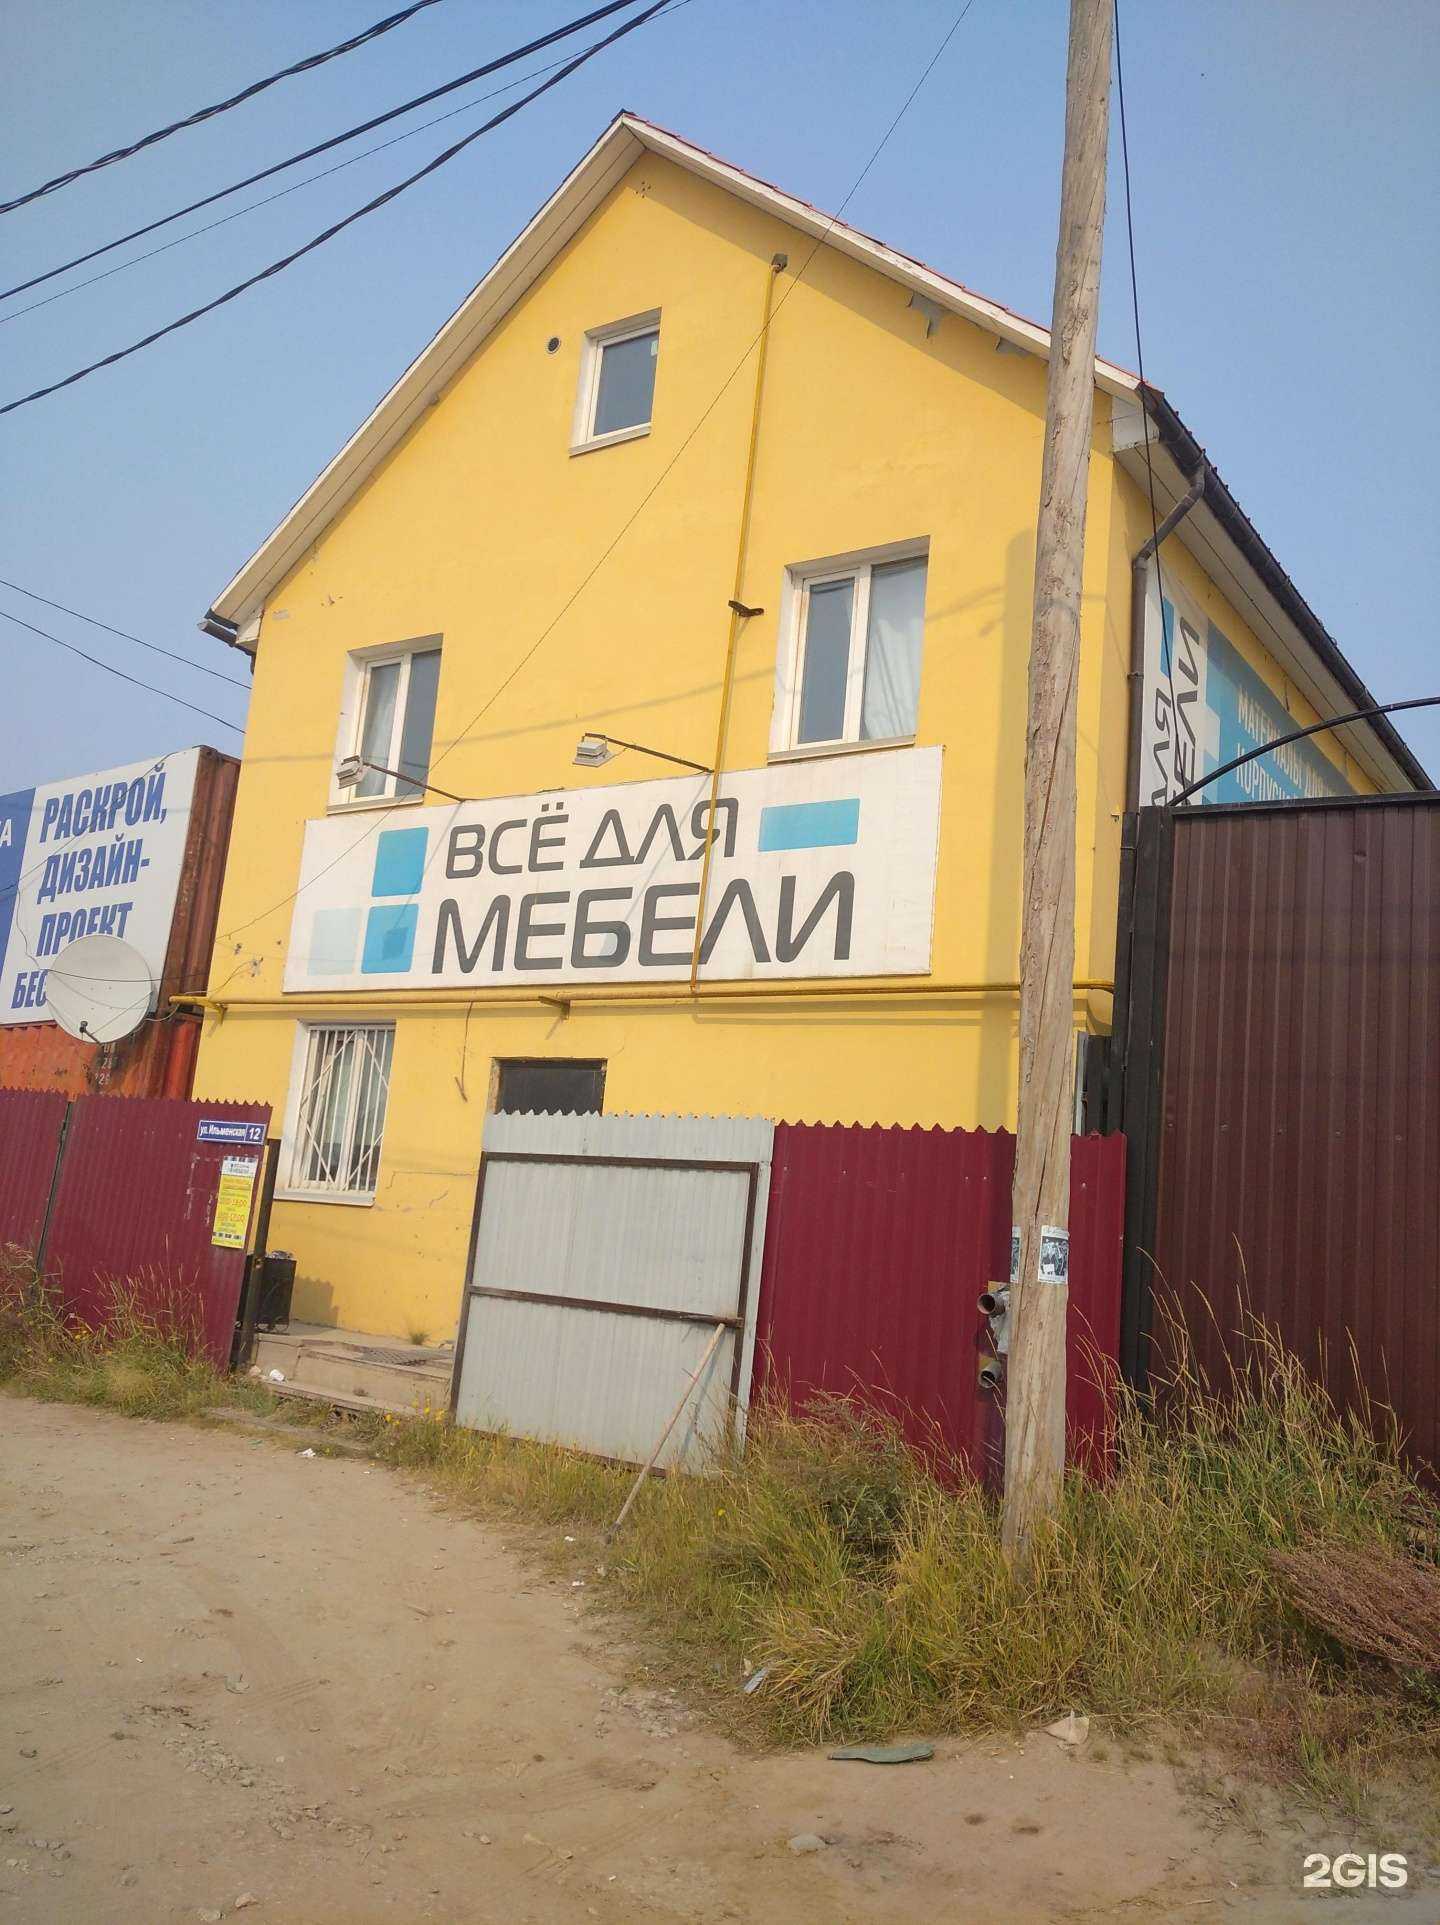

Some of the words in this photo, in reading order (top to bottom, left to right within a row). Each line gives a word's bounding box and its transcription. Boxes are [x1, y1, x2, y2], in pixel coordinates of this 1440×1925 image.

[39, 762, 168, 843] РАСКРОЙ,
[446, 801, 569, 879] ВСЁ
[579, 797, 739, 868] ДЛЯ
[36, 833, 150, 904] ДИЗАЙН-
[36, 901, 134, 957] ПРОЕКТ
[431, 870, 856, 974] МЕБЕЛИ
[11, 968, 49, 1009] БЕС
[249, 1127, 261, 1140] 12
